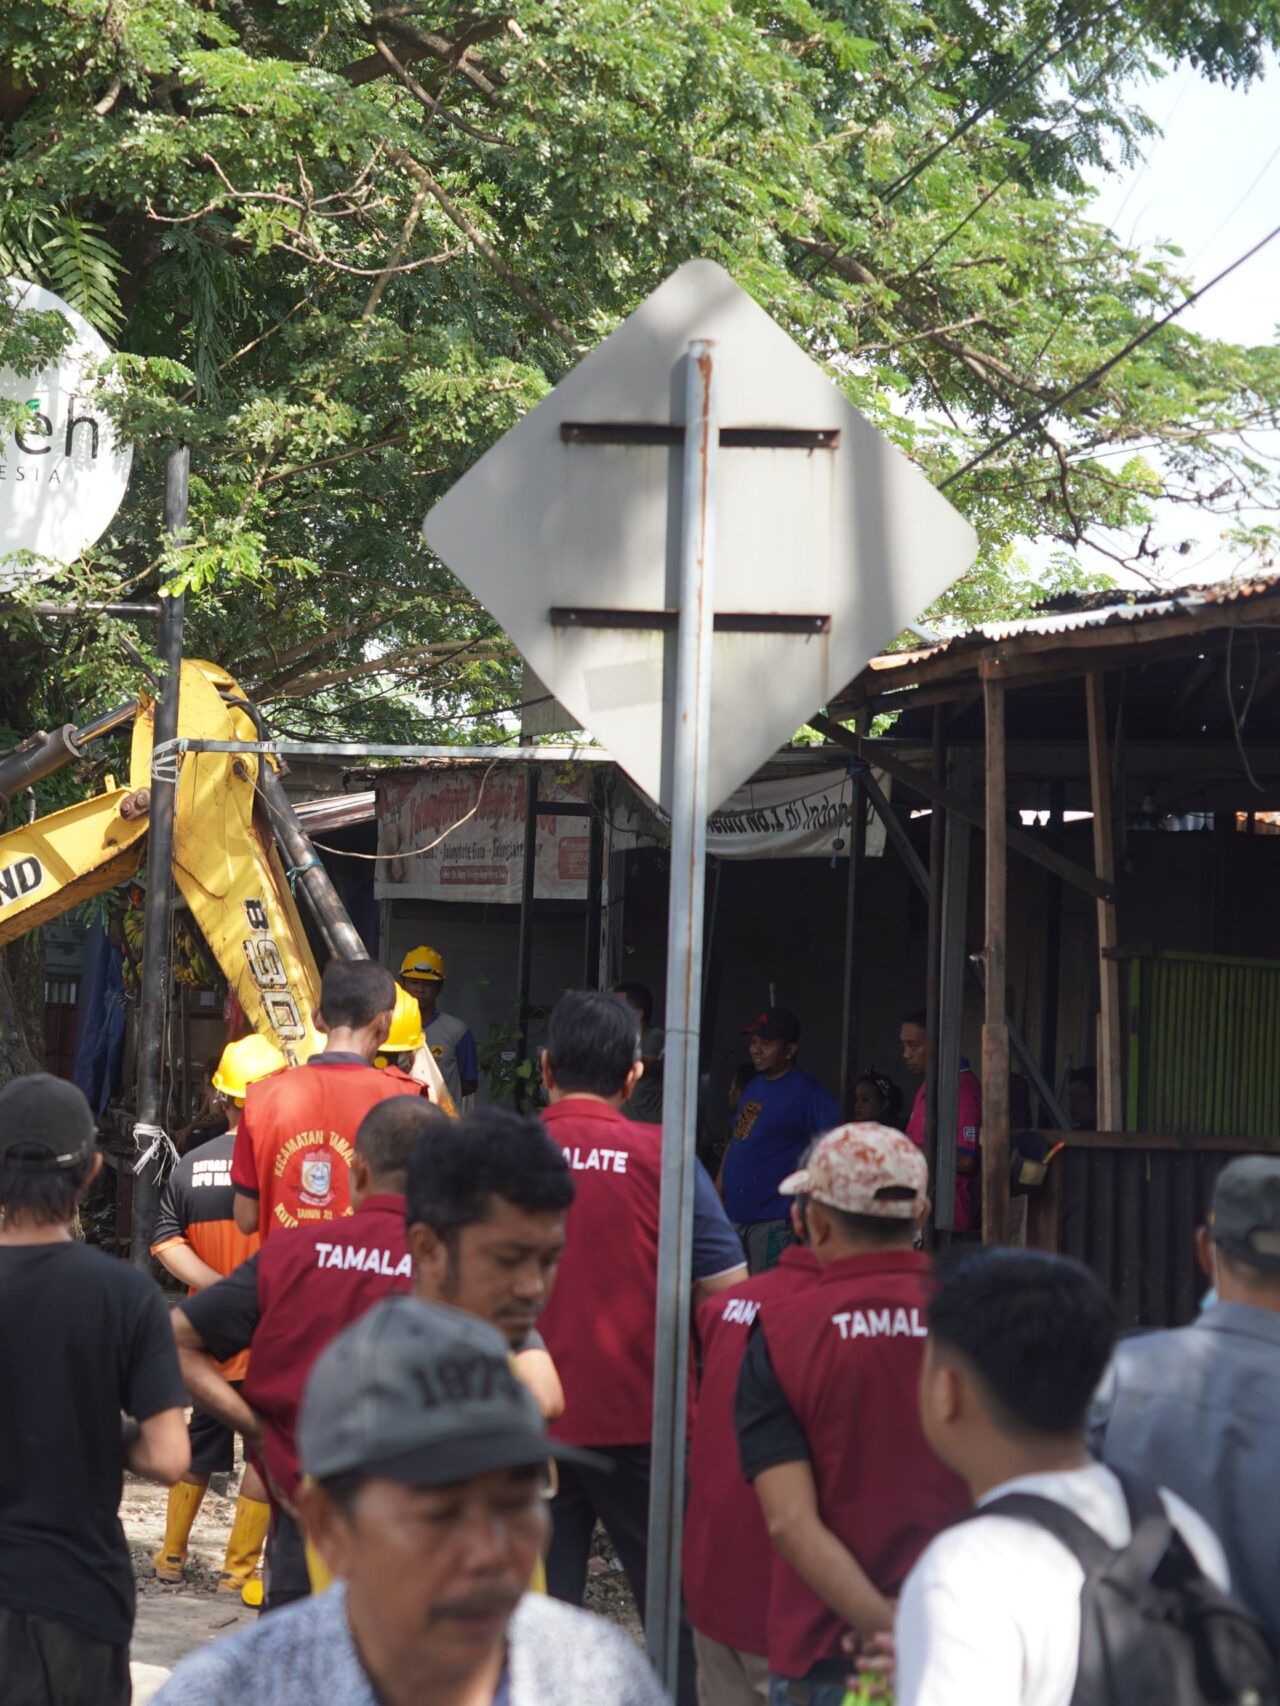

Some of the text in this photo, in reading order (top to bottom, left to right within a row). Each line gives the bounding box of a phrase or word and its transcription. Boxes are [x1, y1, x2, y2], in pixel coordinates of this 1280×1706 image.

[274, 1130, 355, 1177] KECAMATAN TAMAL
[562, 1147, 629, 1174] ALATE
[315, 1242, 412, 1278] TAMALA
[832, 1308, 928, 1339] TAMAL
